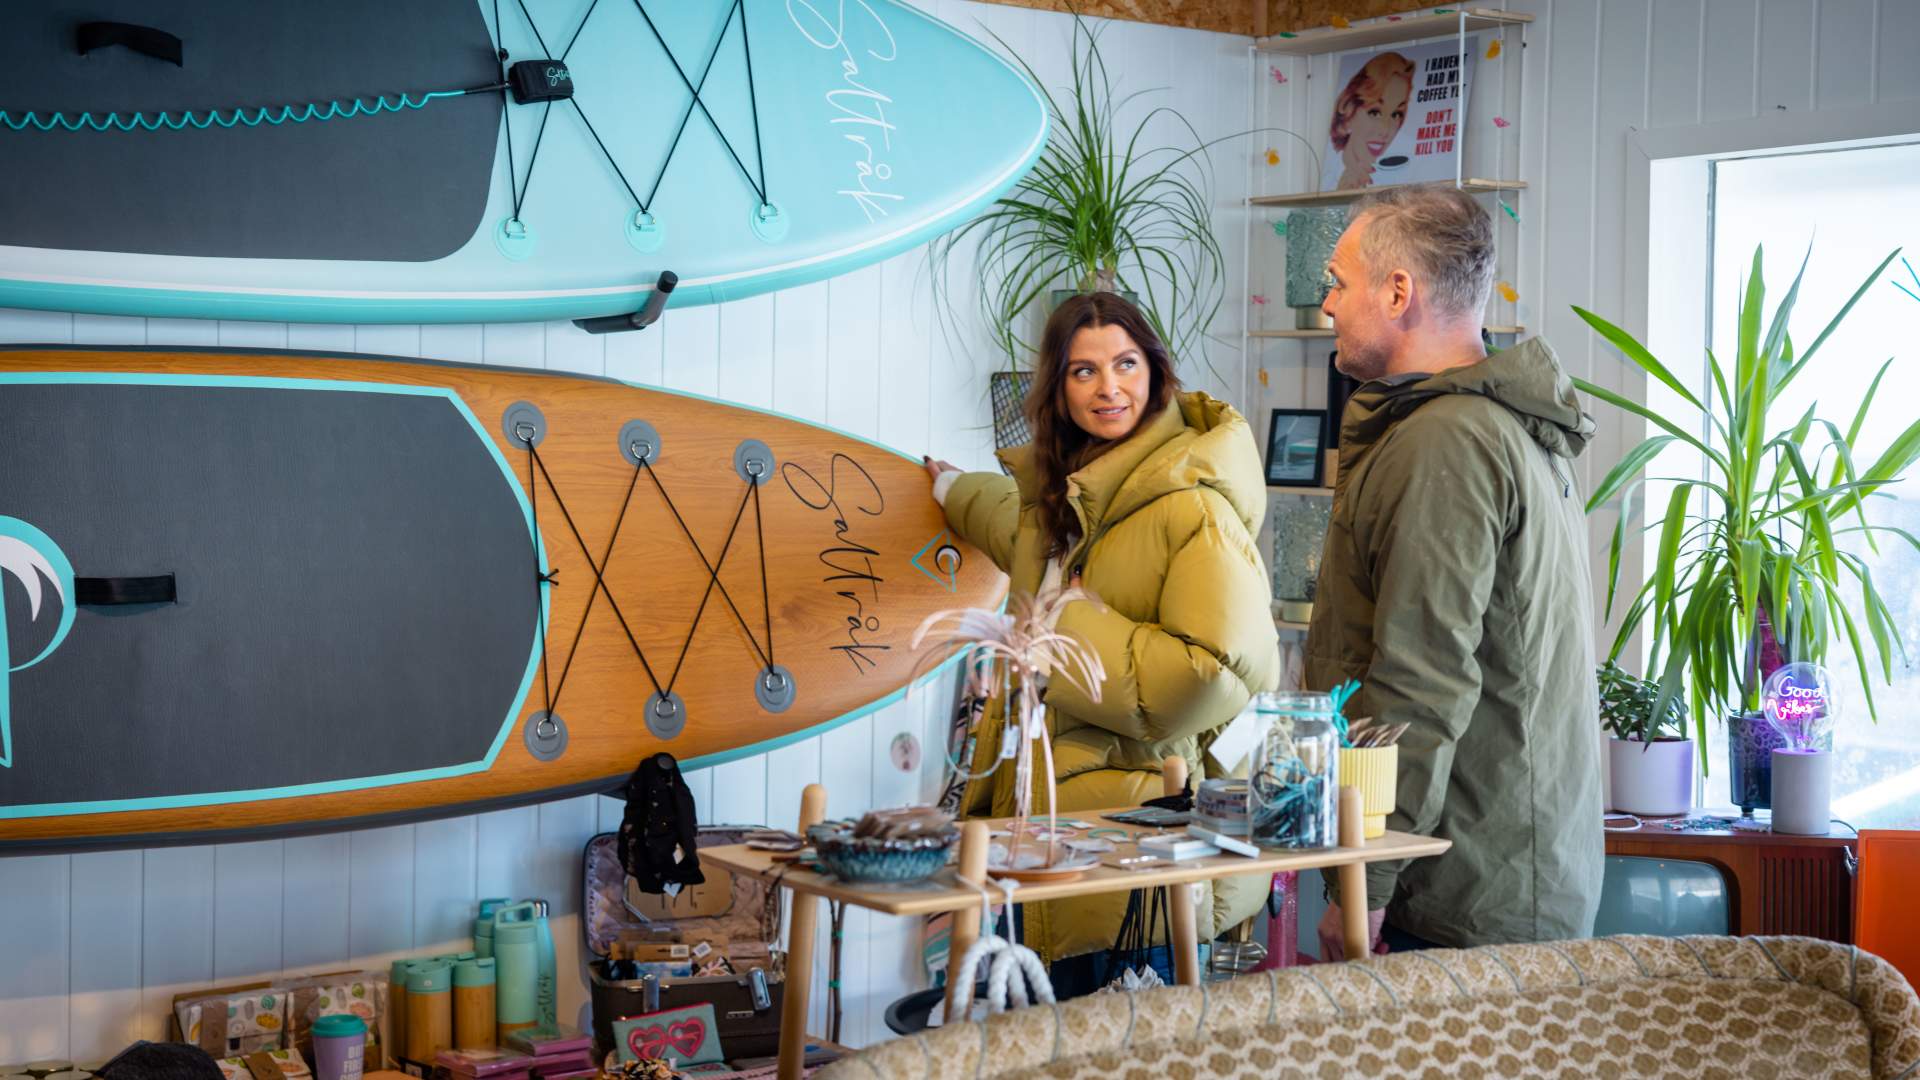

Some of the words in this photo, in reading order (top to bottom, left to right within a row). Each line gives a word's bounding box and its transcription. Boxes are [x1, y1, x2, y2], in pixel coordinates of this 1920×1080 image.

[1425, 59, 1430, 71] I
[1426, 72, 1445, 86] HAD
[1417, 86, 1448, 102] COFFEE
[1450, 84, 1466, 98] YE
[1425, 109, 1452, 124] DON'T
[1416, 125, 1441, 140] MAKE
[1443, 123, 1456, 137] ME
[1414, 142, 1432, 155] KILL
[1436, 139, 1454, 153] YOU
[782, 453, 890, 675] Saltråk
[1778, 675, 1826, 697] Good
